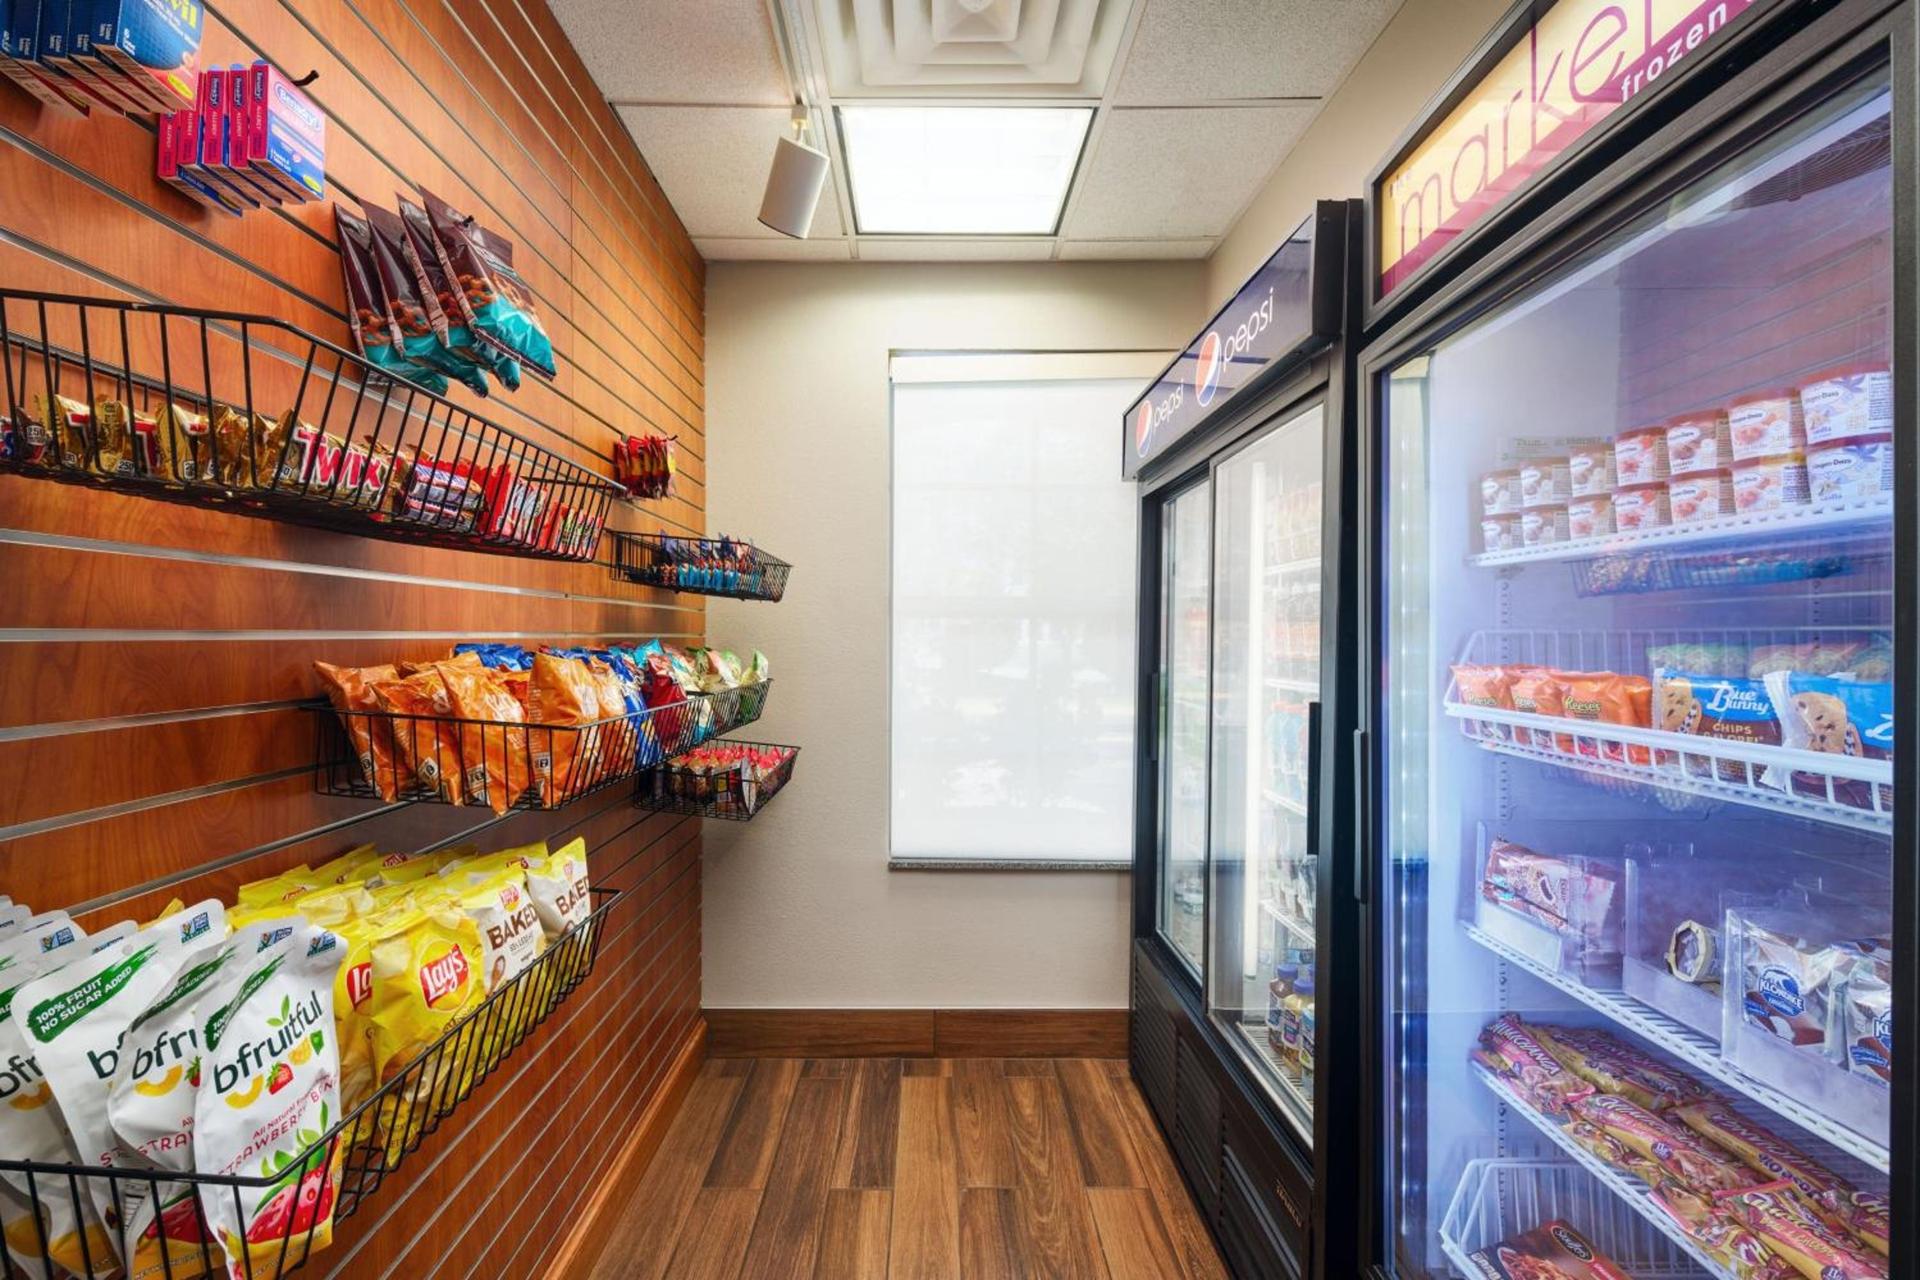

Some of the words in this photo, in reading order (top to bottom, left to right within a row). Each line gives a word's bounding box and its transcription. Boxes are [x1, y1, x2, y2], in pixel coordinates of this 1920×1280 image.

[1621, 3, 1727, 102] frozen
[1222, 286, 1274, 373] pepsi
[1152, 377, 1185, 434] pepsi
[1713, 722, 1752, 734] CHIPS
[486, 903, 538, 951] BAKED
[36, 1001, 66, 1024] 100%
[66, 977, 104, 1005] FRUIT
[40, 1017, 58, 1034] NO
[61, 990, 102, 1021] SUGAR
[104, 966, 133, 993] ADDED
[213, 990, 323, 1095] bfruitful
[253, 1126, 266, 1140] All
